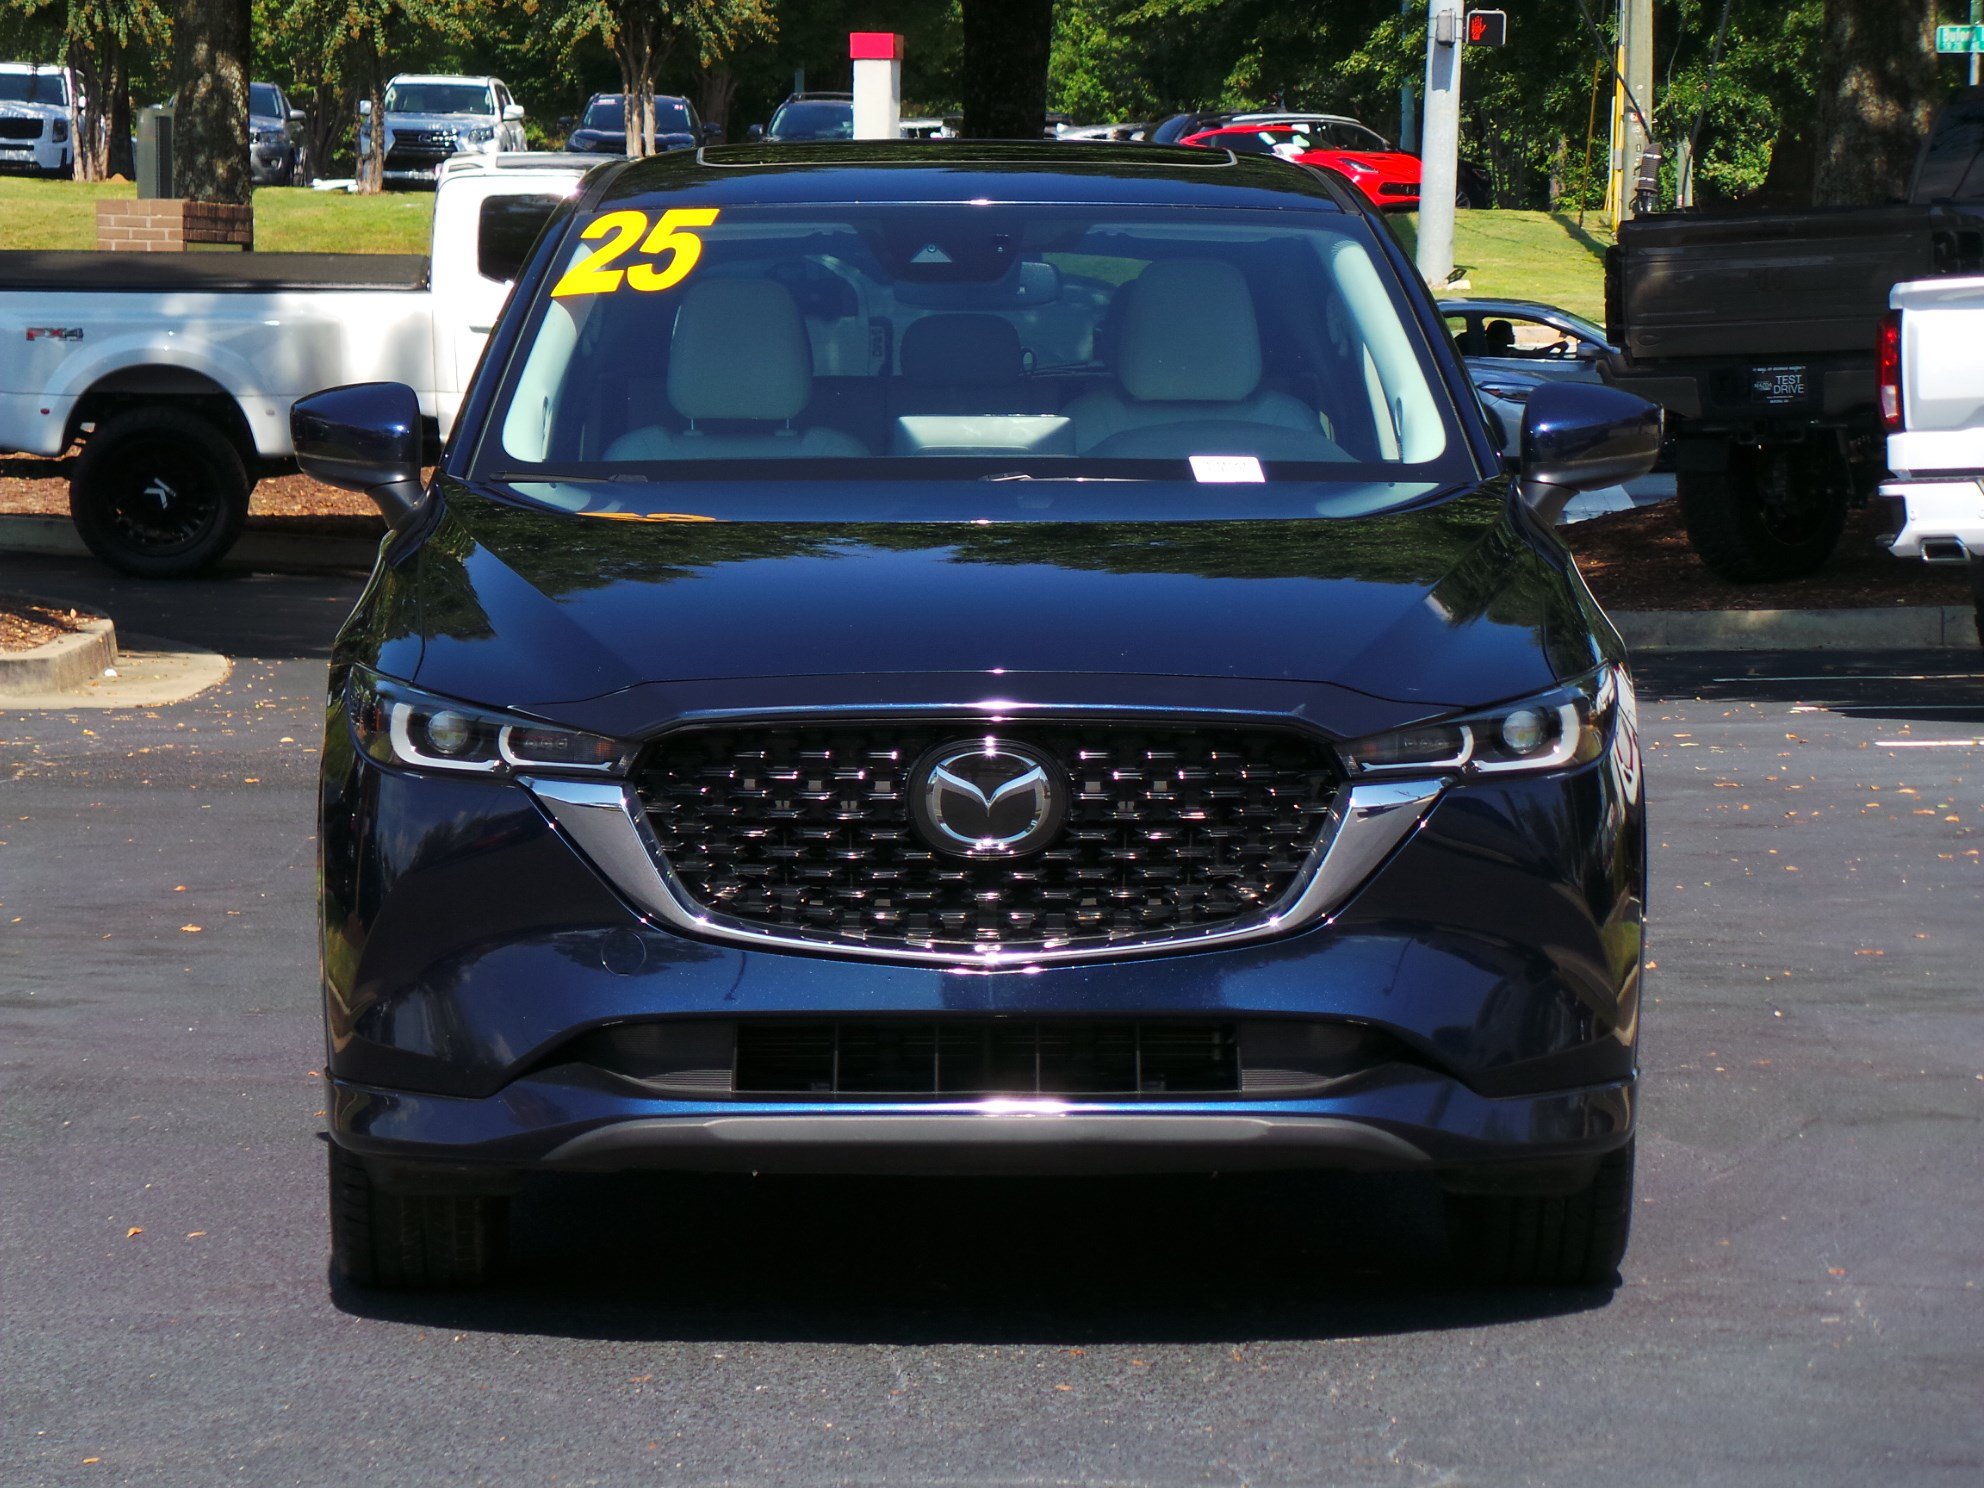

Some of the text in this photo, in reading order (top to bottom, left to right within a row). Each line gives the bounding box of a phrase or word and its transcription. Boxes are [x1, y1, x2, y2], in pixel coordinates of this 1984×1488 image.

[550, 208, 720, 297] 25
[26, 327, 84, 341] FX4
[1775, 374, 1802, 385] TEST
[1773, 383, 1805, 394] DRIVE
